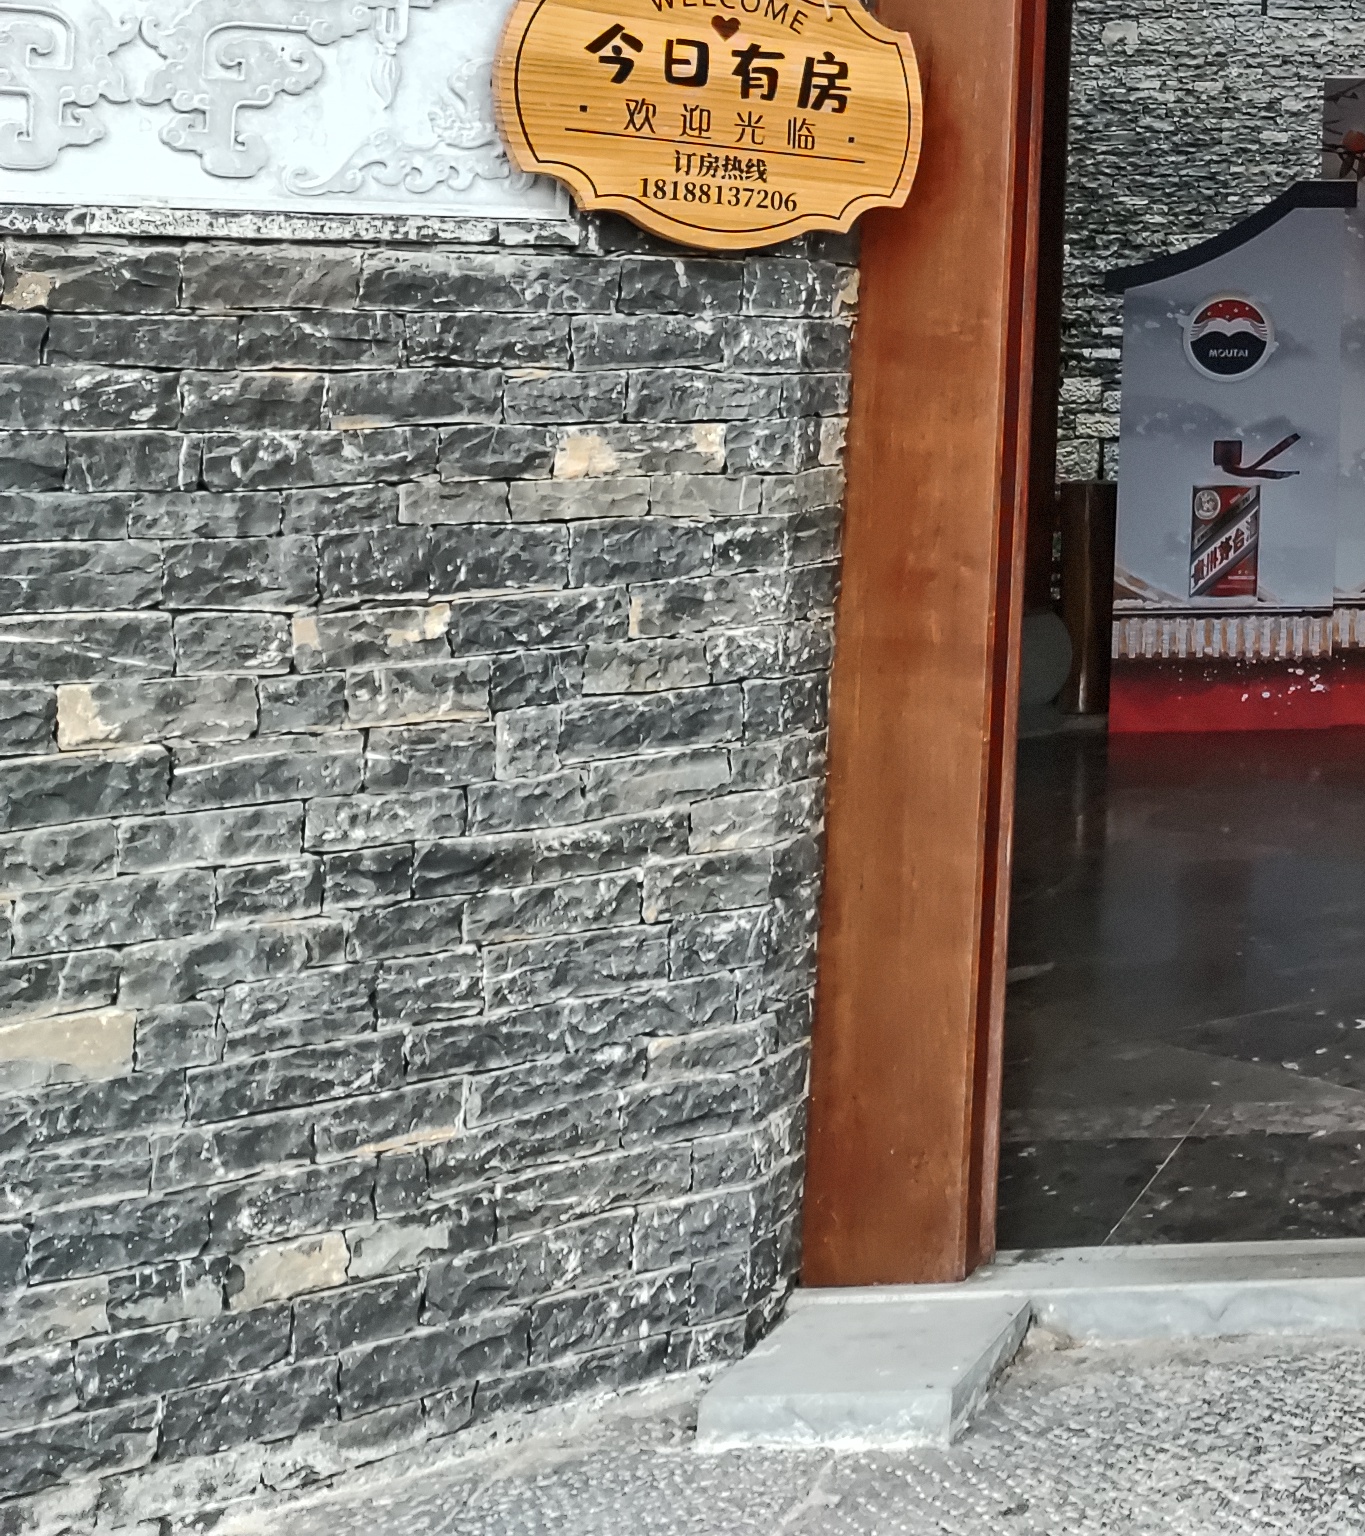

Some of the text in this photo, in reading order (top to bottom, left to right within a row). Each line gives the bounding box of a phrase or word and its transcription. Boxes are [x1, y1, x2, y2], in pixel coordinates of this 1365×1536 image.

[584, 22, 852, 114] 今日有房
[624, 97, 816, 151] 欢迎光临
[672, 148, 769, 184] 订房热线
[638, 177, 798, 213] 18188137206
[1207, 347, 1250, 359] MOUTAI
